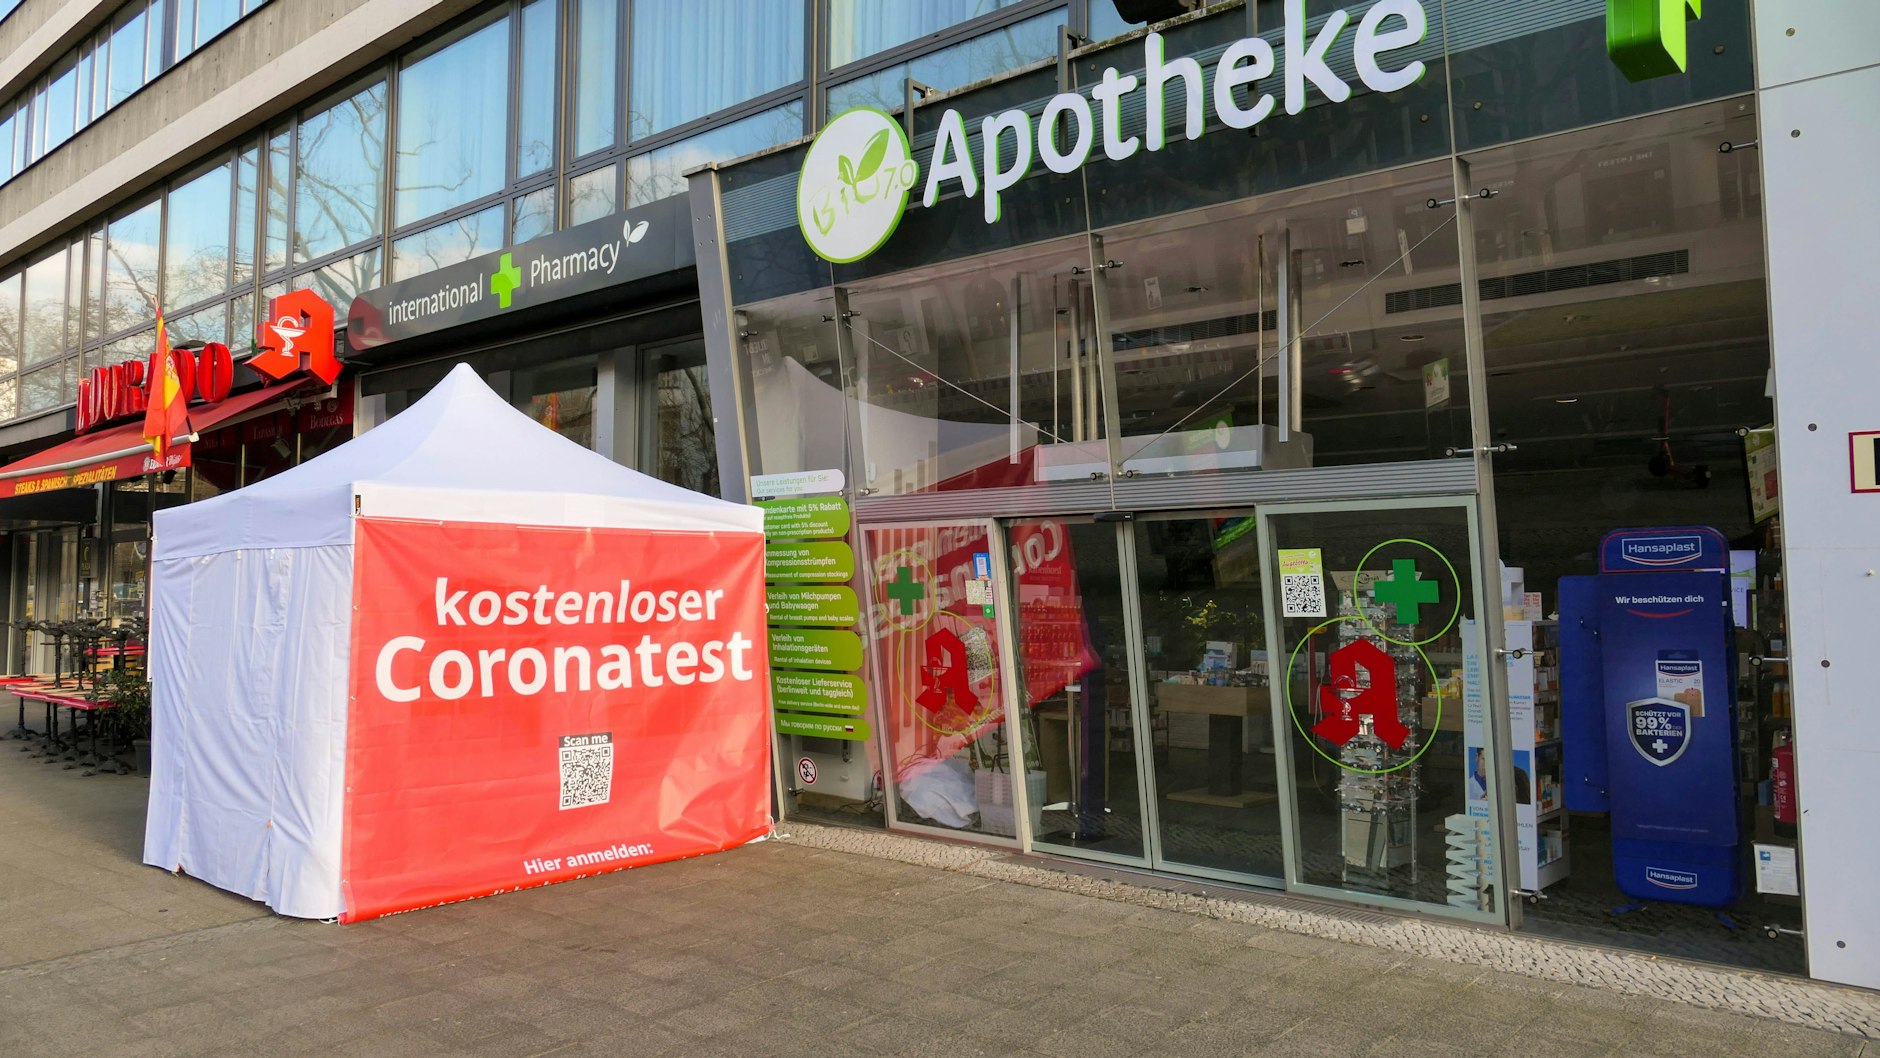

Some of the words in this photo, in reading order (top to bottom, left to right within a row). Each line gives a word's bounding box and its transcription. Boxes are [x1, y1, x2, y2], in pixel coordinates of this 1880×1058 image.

[922, 0, 1427, 224] Apotheke
[388, 273, 483, 325] international
[531, 240, 621, 288] Pharmacy
[41, 476, 71, 490] SPANISCH
[72, 465, 117, 486] SPEZIALITÄTEN
[764, 505, 796, 514] ndenkarte
[796, 504, 807, 512] mit
[808, 503, 819, 512] 5%
[820, 502, 842, 511] Rabatt
[1628, 542, 1696, 554] Hansaplast
[826, 571, 849, 579] stockings
[434, 576, 724, 627] kostenloser
[767, 592, 788, 600] Verleih
[800, 592, 842, 602] Milchpumpen
[1615, 596, 1631, 604] Wir
[1631, 595, 1683, 604] beschützen
[1684, 594, 1705, 603] dich
[781, 602, 819, 611] Babywaagen
[827, 614, 839, 622] baby
[771, 633, 792, 642] Verleih
[772, 643, 829, 654] Inhalationsgeräten
[375, 630, 753, 703] Coronatest
[1660, 664, 1698, 672] Hansaplast
[776, 676, 811, 685] Kostenloser
[812, 678, 853, 688] Lieferservice
[777, 684, 809, 695] (berlinweit
[809, 688, 822, 696] und
[822, 688, 854, 699] taggleich)
[1635, 709, 1667, 717] SCHÜTZT
[791, 721, 814, 730] говорим
[814, 722, 822, 730] по
[823, 724, 842, 733] русски
[1635, 716, 1672, 730] 99%
[1636, 729, 1683, 737] BAKTERIEN
[563, 734, 590, 747] Scan
[591, 734, 609, 745] me
[523, 855, 562, 876] Hier
[567, 841, 655, 869] anmelden:
[1649, 871, 1694, 883] Hansaplast
